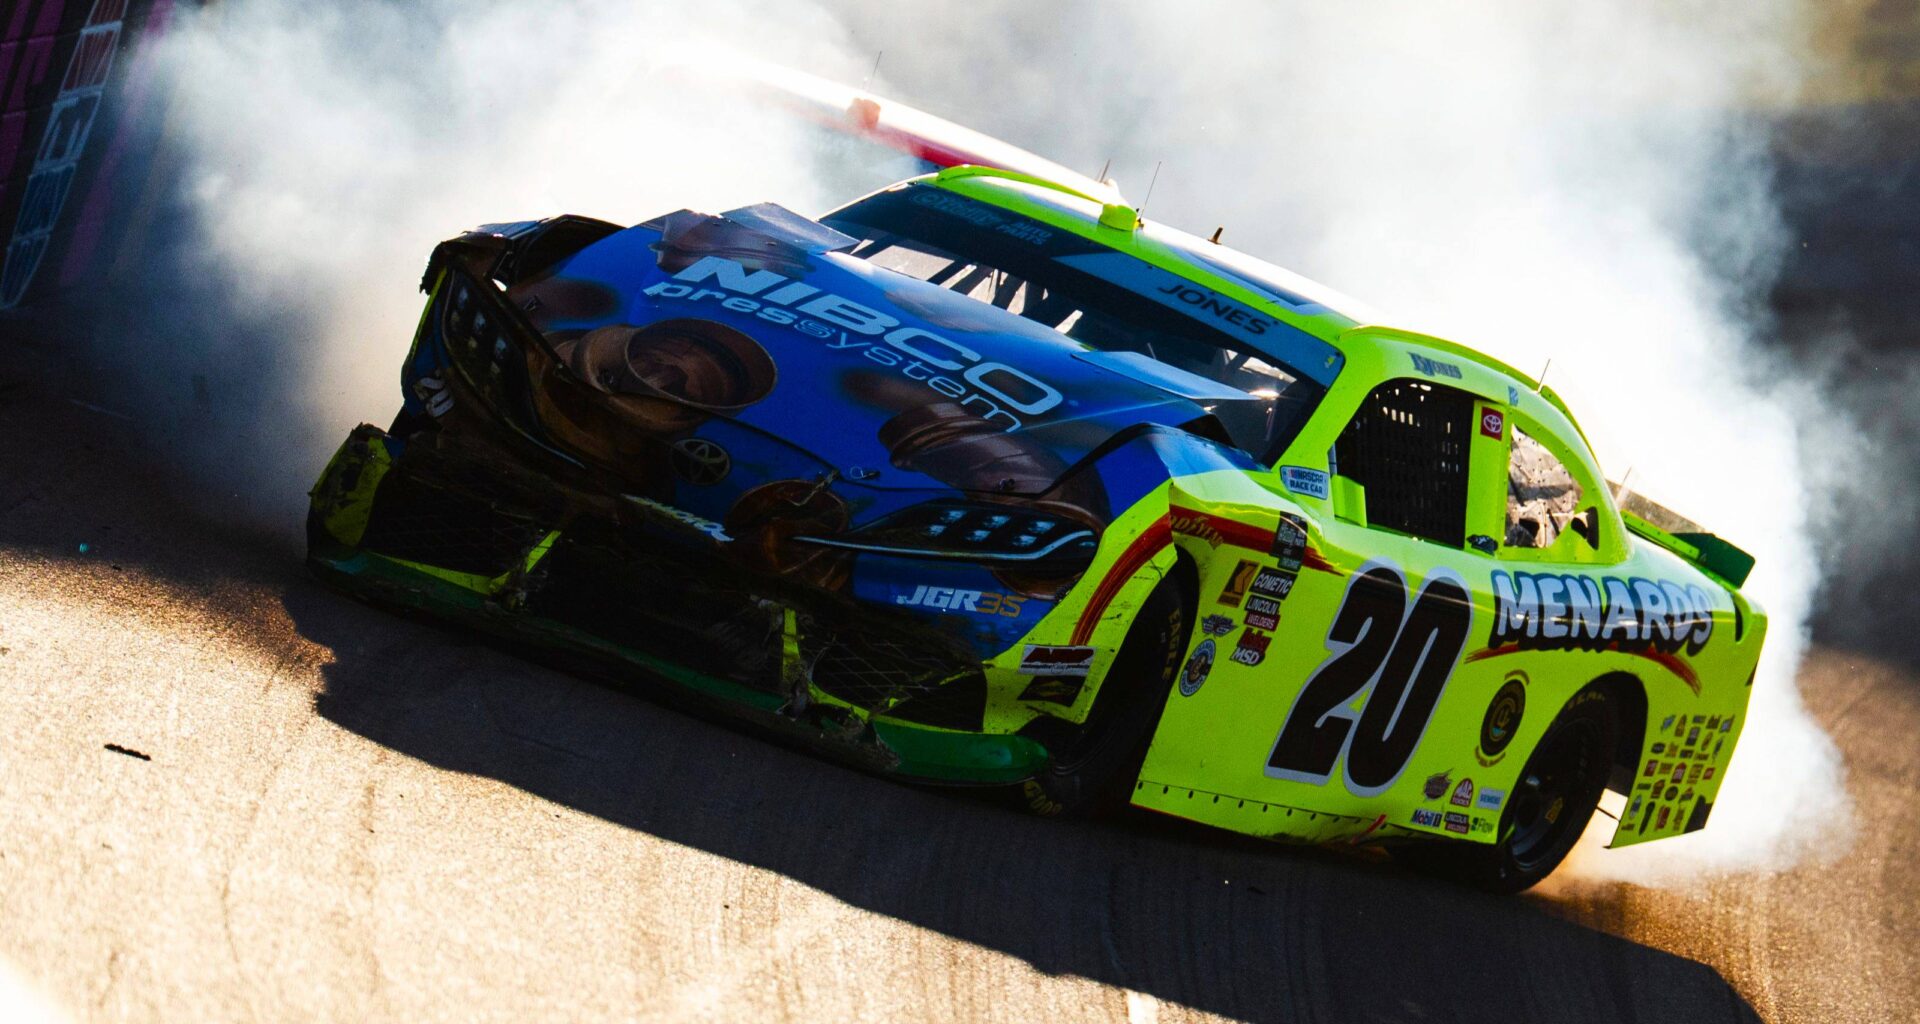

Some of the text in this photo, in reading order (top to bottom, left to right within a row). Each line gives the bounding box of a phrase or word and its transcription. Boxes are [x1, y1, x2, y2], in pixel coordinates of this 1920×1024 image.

[1157, 284, 1271, 335] JONES
[672, 255, 1063, 415] NIBCO
[1290, 479, 1323, 494] RACE CAR
[1253, 572, 1293, 594] COMETIC
[1246, 597, 1279, 615] LINCOLN
[1490, 570, 1714, 656] MENARDS
[1246, 613, 1276, 630] WELDERS
[1230, 647, 1260, 665] MSD
[1264, 556, 1474, 797] 20
